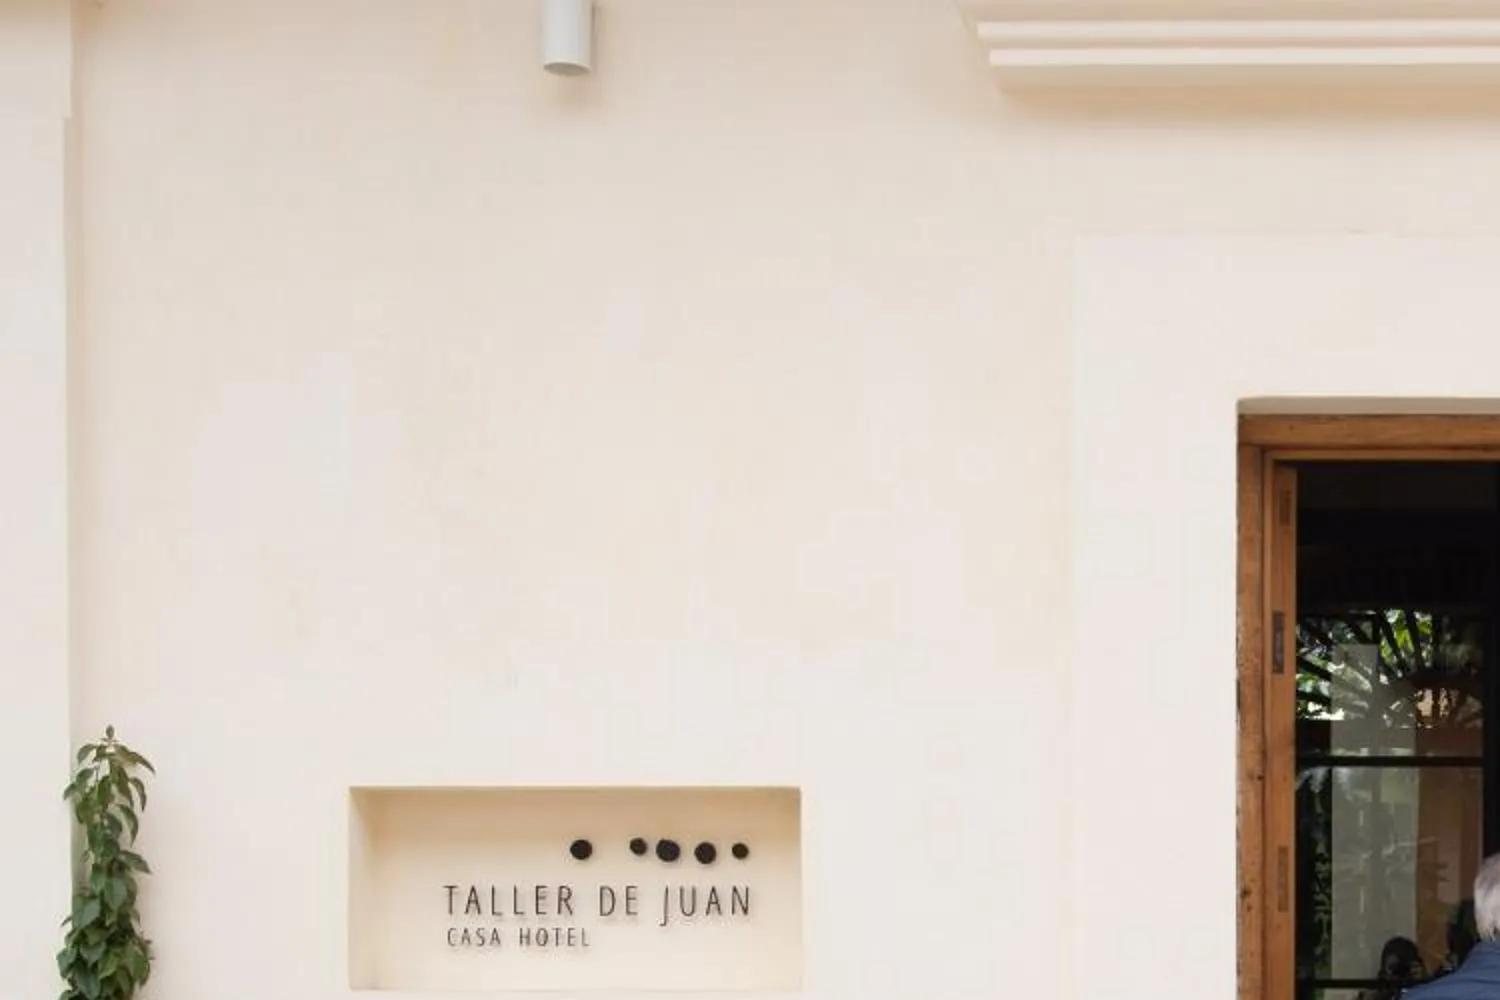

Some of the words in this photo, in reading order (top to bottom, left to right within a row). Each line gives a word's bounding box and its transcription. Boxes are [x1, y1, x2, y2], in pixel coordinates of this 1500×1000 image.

[443, 884, 575, 917] TALLER
[599, 884, 639, 917] DE
[658, 884, 750, 927] JUAN
[446, 926, 502, 947] CASA
[519, 926, 590, 947] HOTEL
